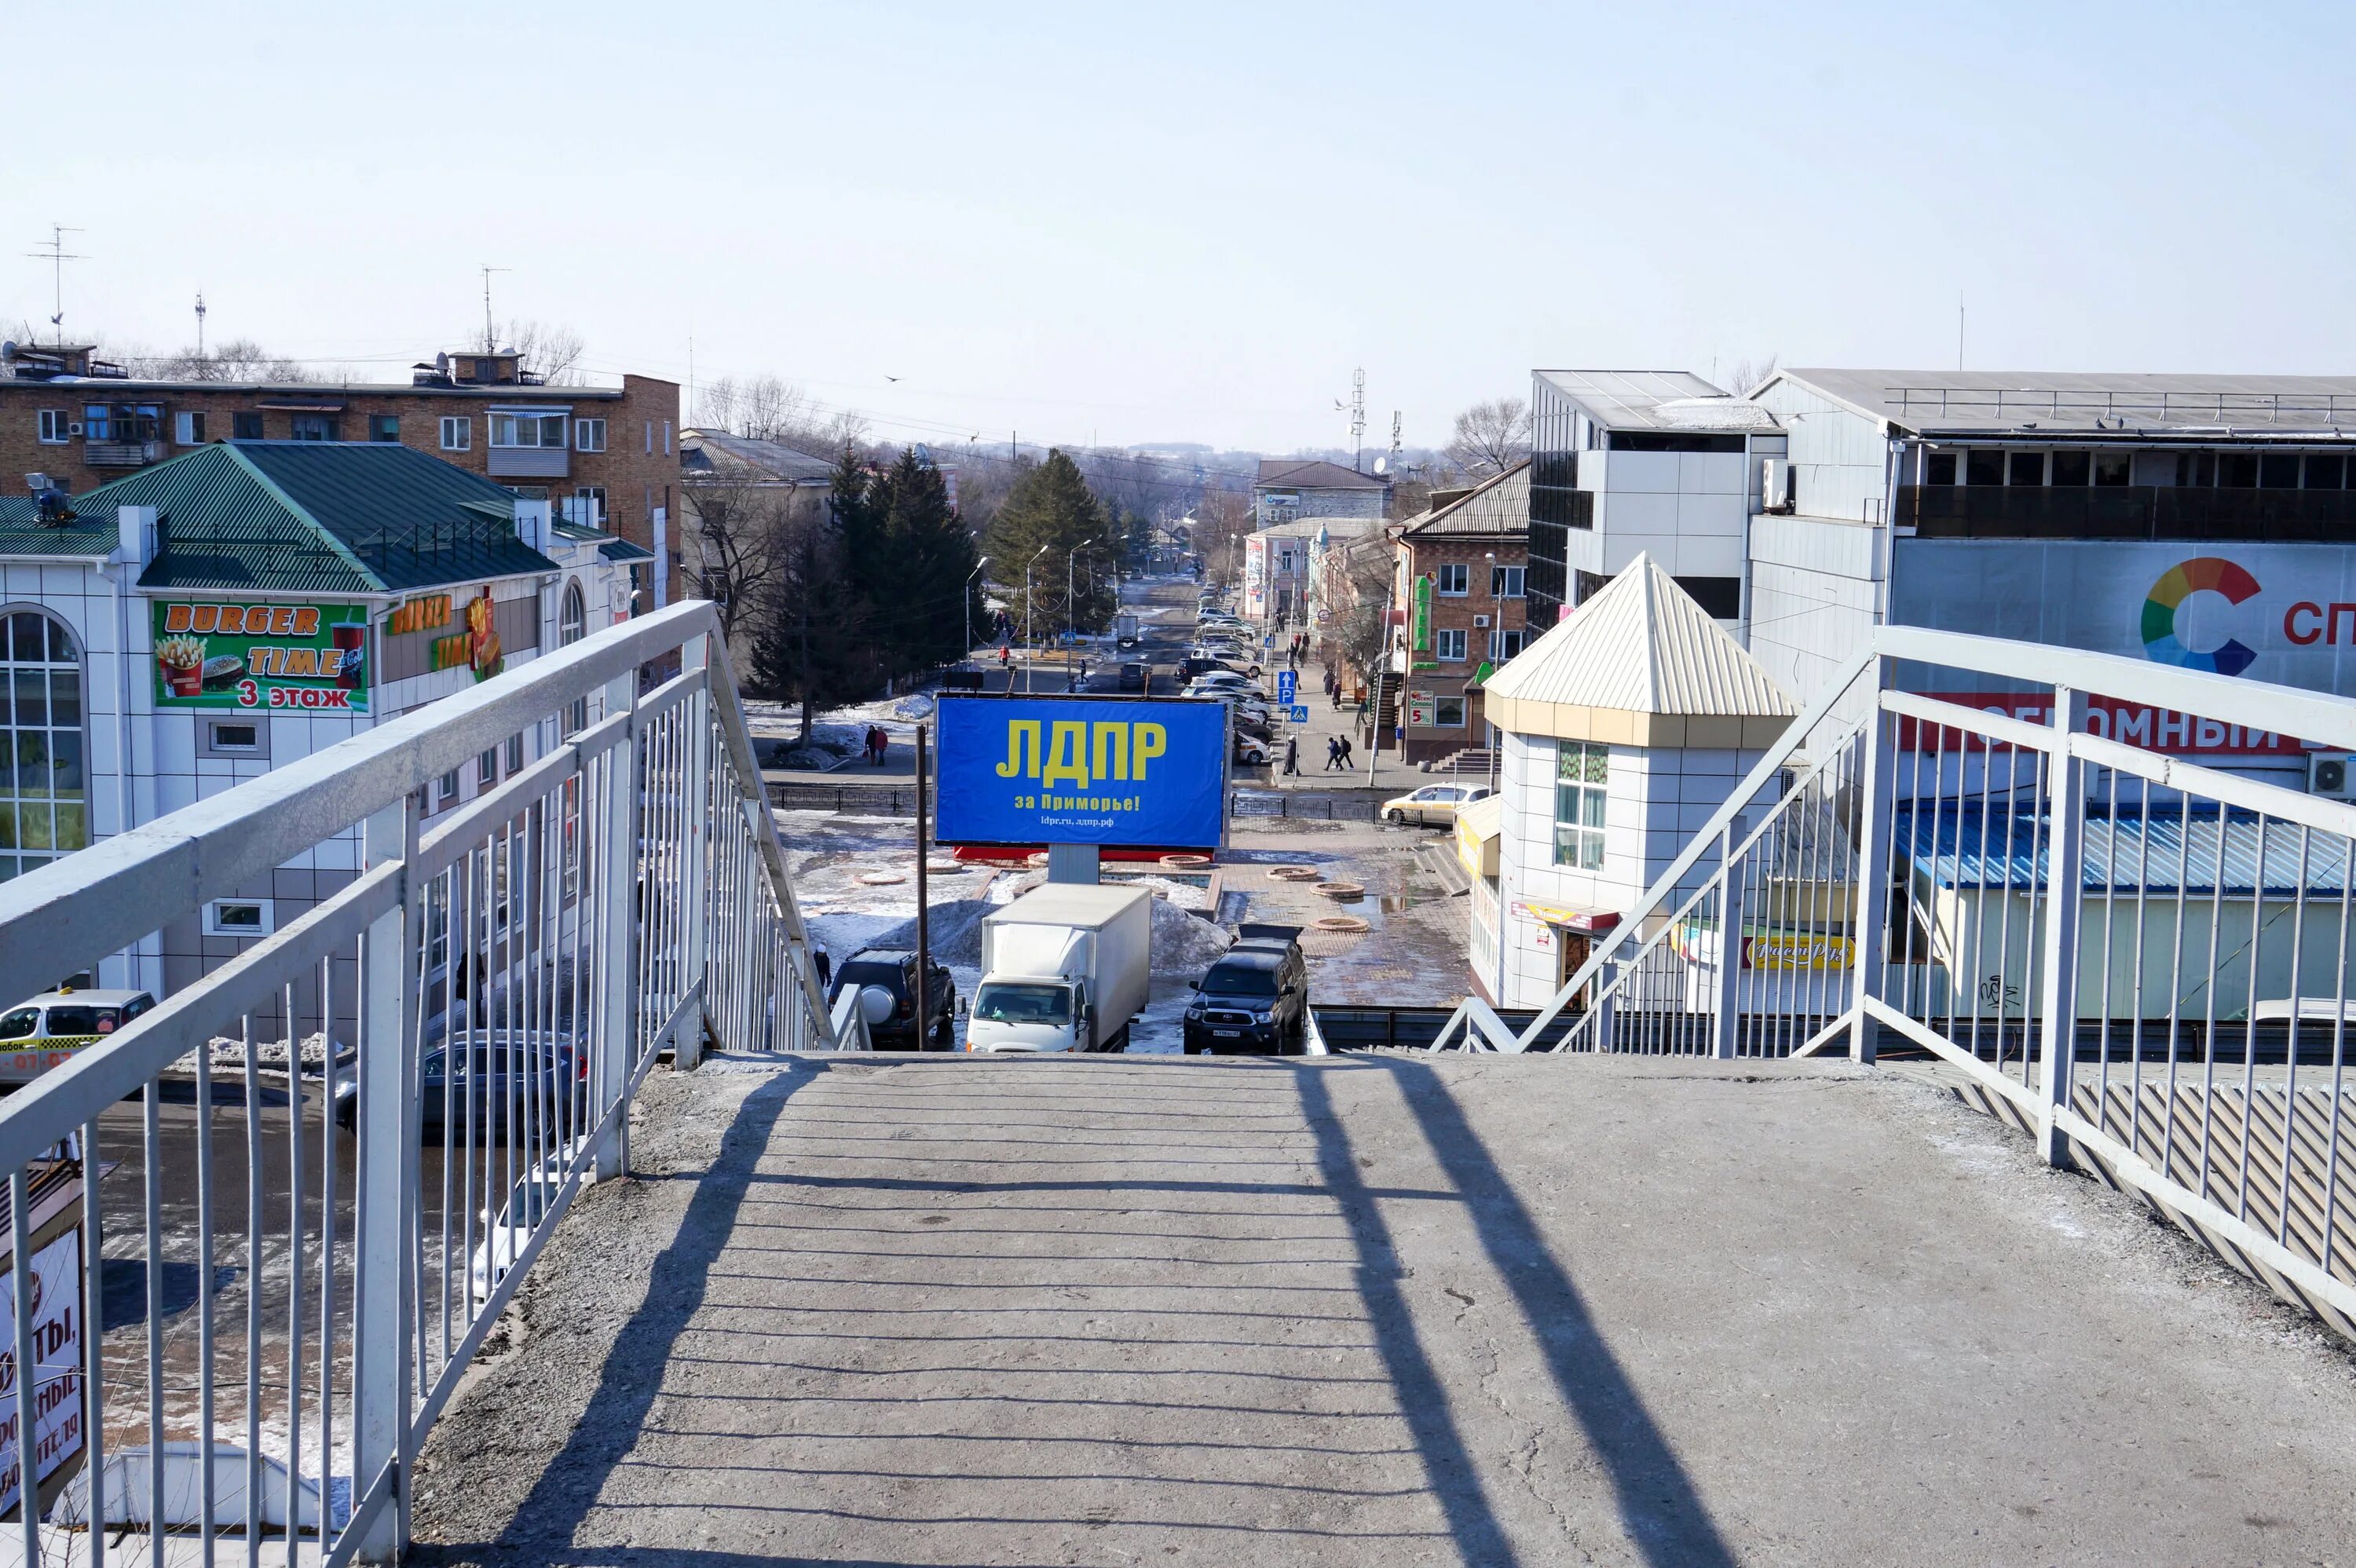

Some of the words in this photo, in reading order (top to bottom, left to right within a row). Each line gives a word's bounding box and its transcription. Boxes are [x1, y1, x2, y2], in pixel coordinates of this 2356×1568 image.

[165, 604, 320, 636] BURGER
[248, 646, 345, 678] TIME
[238, 679, 258, 707] 3
[269, 688, 352, 709] этаж
[996, 719, 1167, 790] ЛДПР
[1015, 795, 1035, 809] за
[1041, 794, 1140, 813] Приморье!
[1041, 816, 1074, 826] ldpr.ru,
[1076, 818, 1114, 828] лдпр.рф
